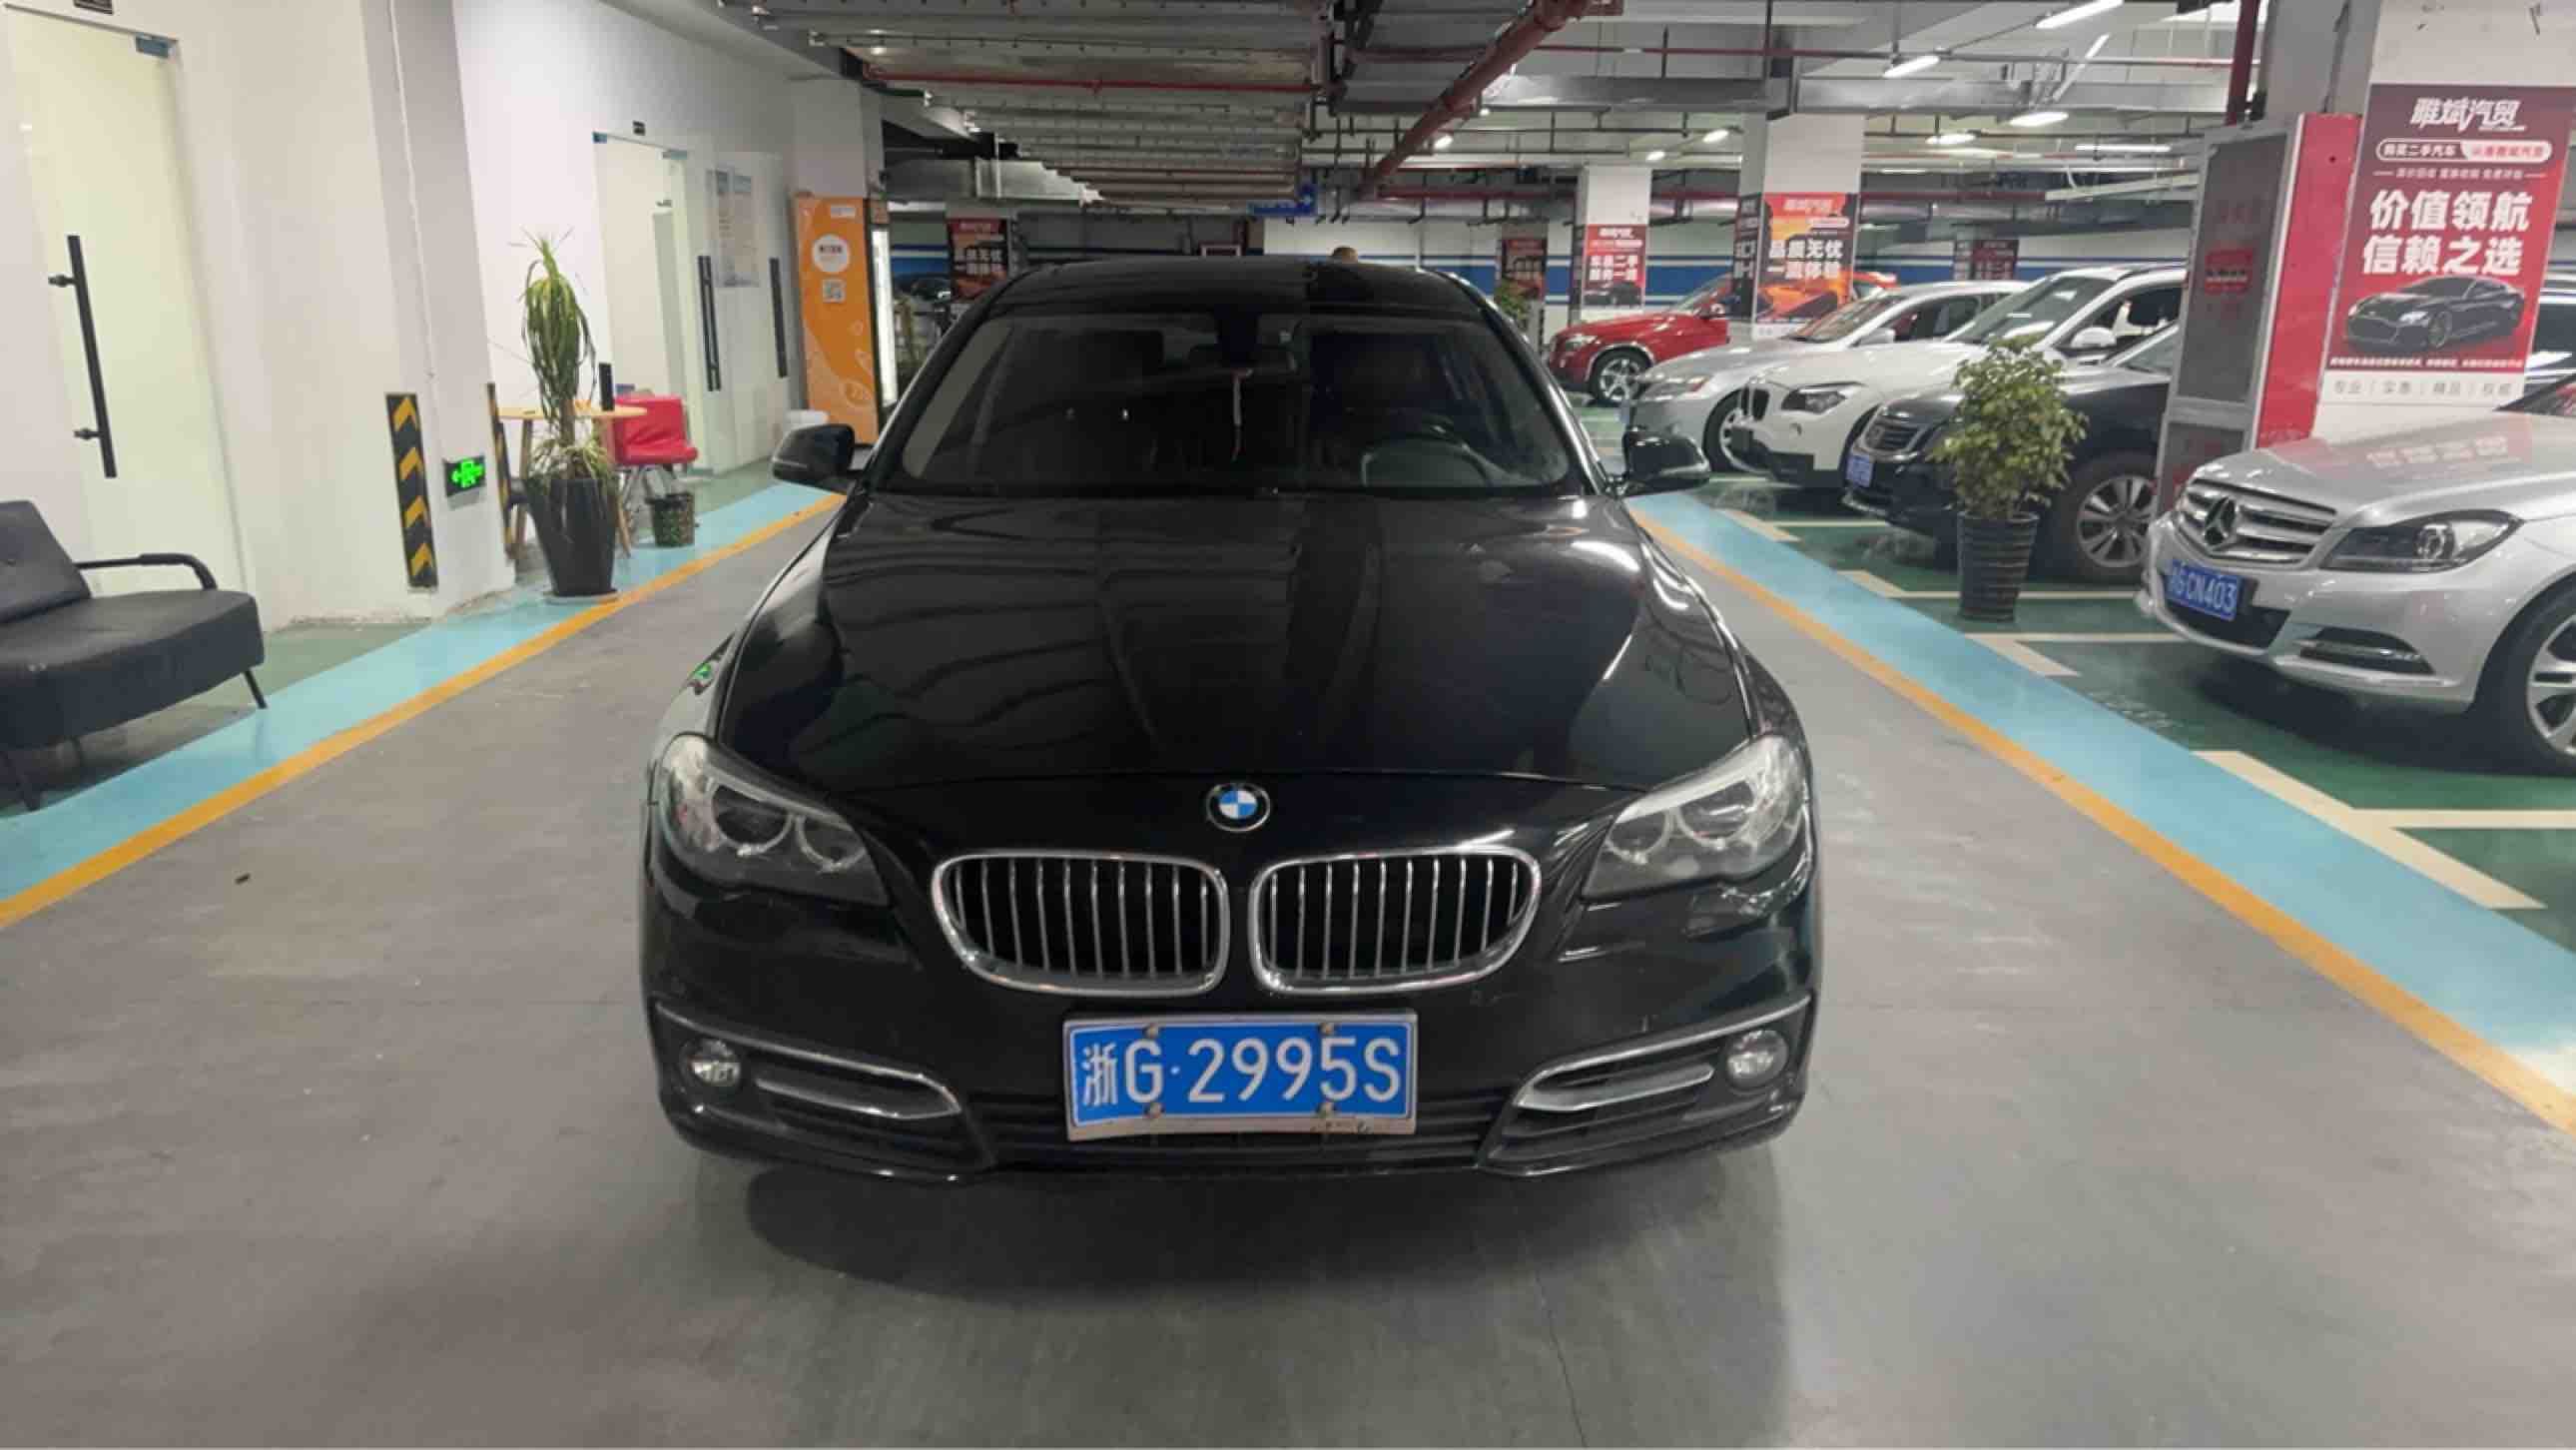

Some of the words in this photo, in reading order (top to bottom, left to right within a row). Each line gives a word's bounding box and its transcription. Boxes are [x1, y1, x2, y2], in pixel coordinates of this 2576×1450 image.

[2369, 190, 2533, 231] 价值领航
[2362, 236, 2523, 276] 信赖之选
[1081, 1036, 1400, 1107] 浙G·2995S
